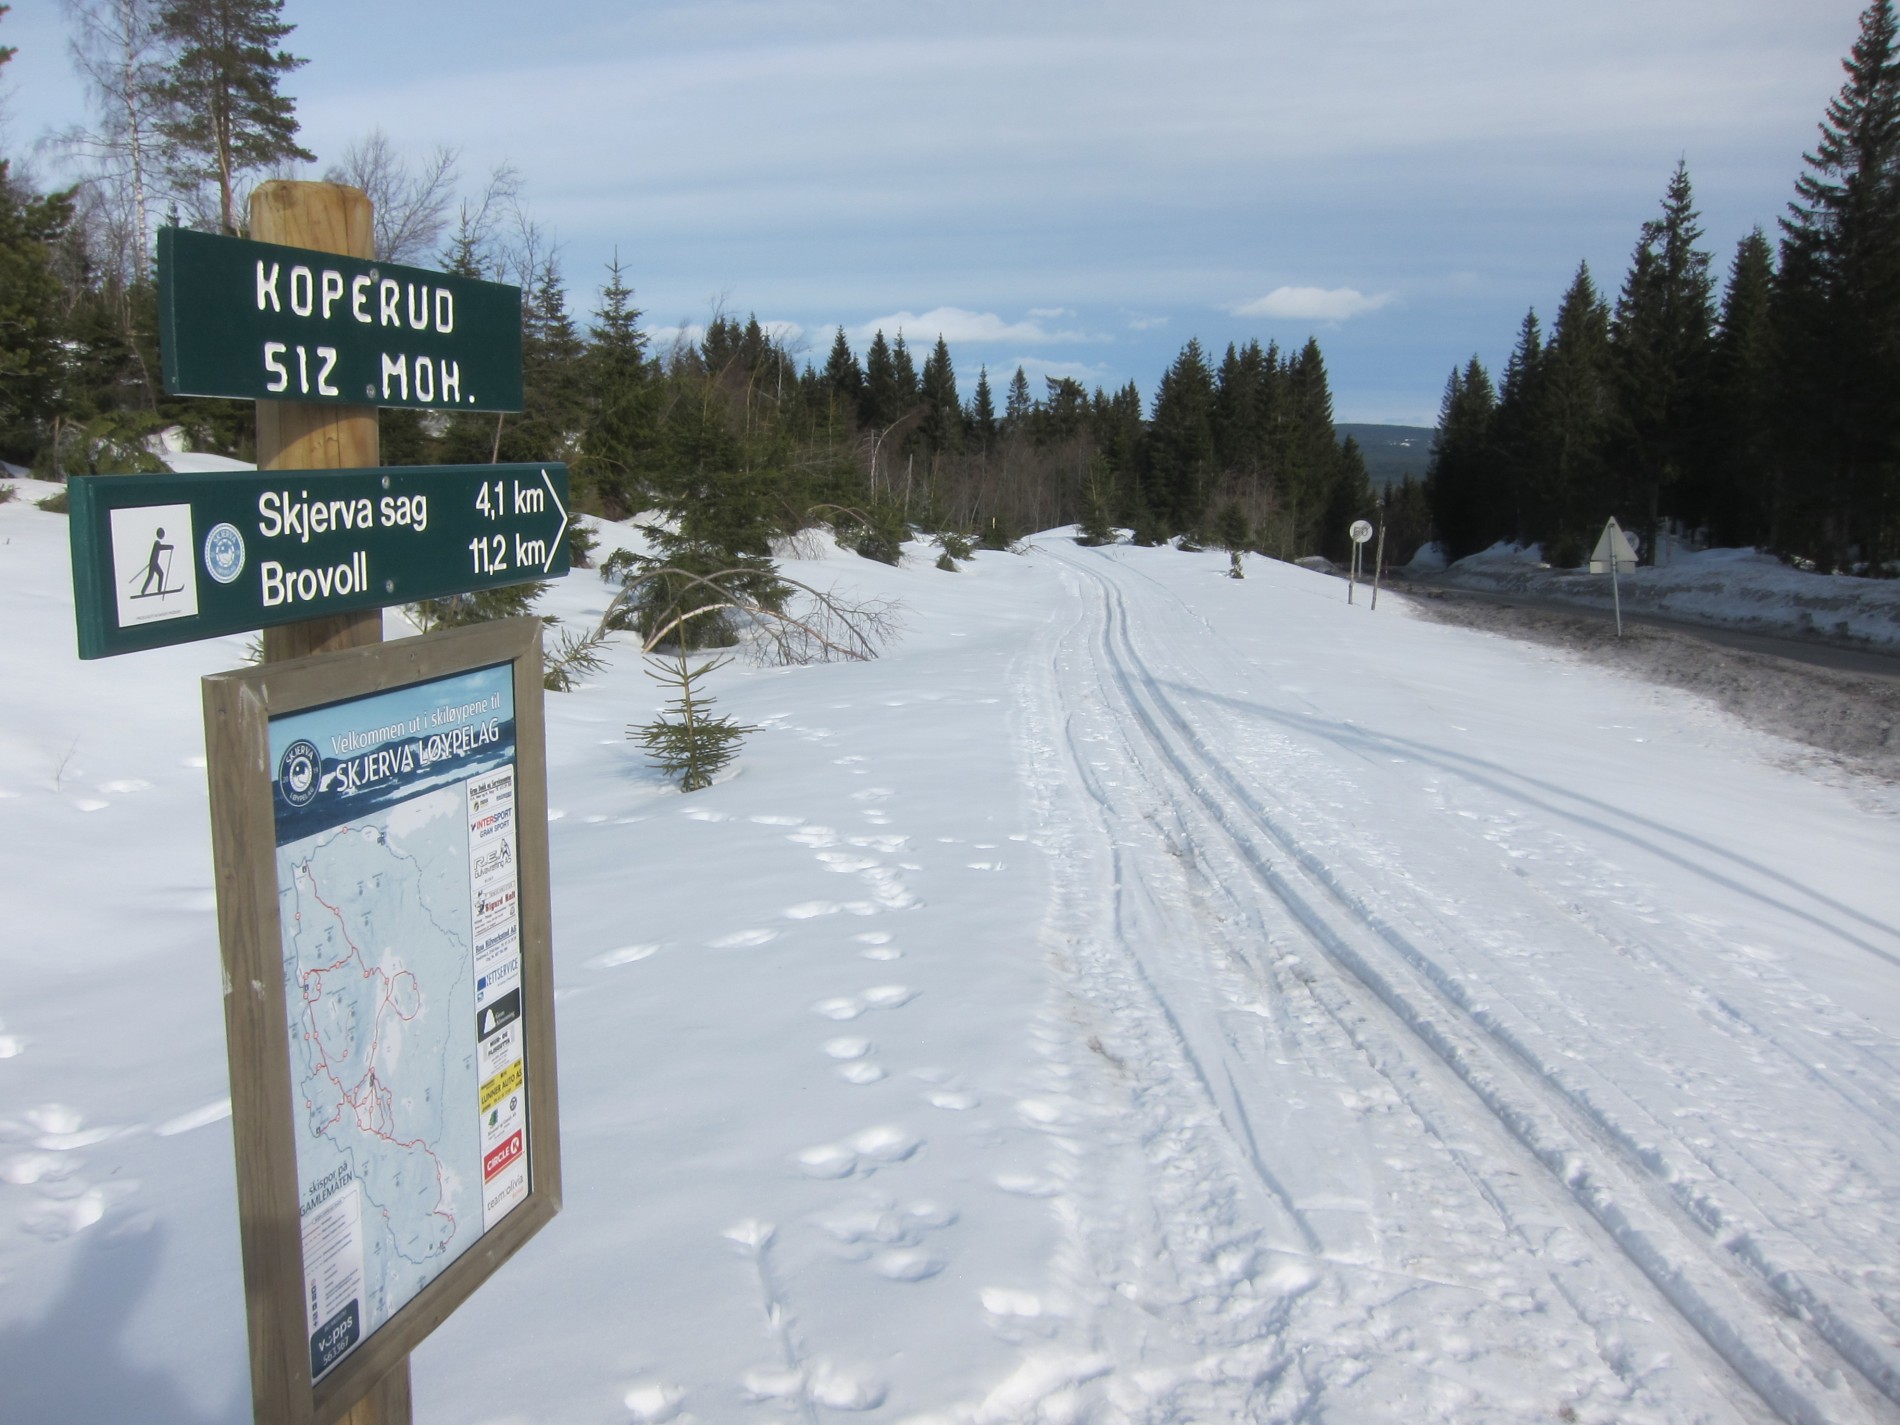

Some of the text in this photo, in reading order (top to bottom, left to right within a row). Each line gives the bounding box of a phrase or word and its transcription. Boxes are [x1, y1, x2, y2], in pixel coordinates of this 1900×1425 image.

[256, 260, 454, 334] KOPERUD
[264, 341, 475, 404] 512 MOH.
[258, 489, 428, 544] Skjerva sag
[475, 480, 545, 521] 4,1 km
[260, 533, 546, 607] Brovoll 11,2 km
[331, 692, 501, 755] Velkommen ut i skiløypene til
[285, 744, 315, 766] SKJERVA
[335, 717, 500, 793] SKJERVA LØYPELAG
[476, 807, 512, 830] INTERSPORT
[494, 819, 510, 832] SPORT
[308, 1170, 337, 1197] skispor
[337, 1160, 348, 1178] på
[486, 1146, 510, 1172] CIRCLE
[300, 1170, 353, 1218] GAMLEMATEN
